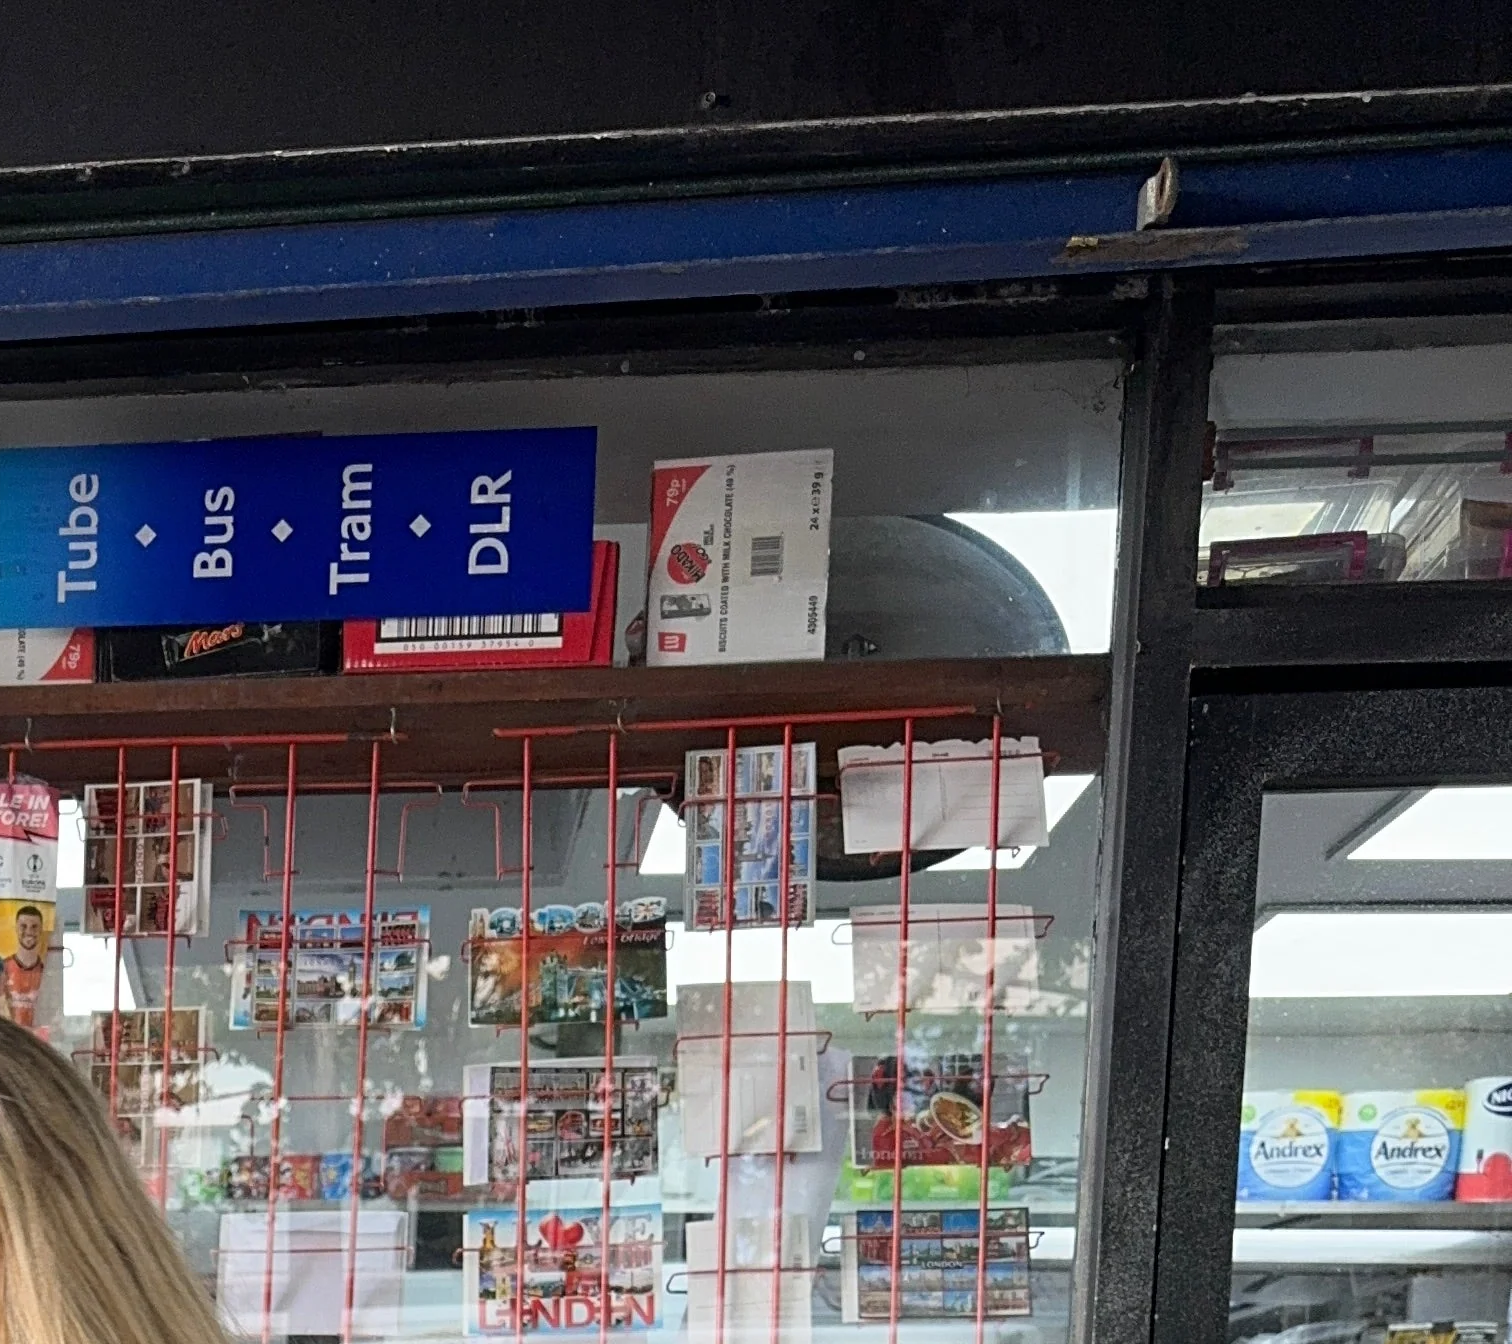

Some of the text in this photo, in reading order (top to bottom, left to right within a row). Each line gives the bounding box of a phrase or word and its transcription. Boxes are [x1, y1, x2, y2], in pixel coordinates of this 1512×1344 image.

[666, 479, 681, 507] 79p
[57, 472, 100, 604] Tube
[193, 485, 235, 579] Bus
[329, 464, 373, 595] Tram
[469, 470, 512, 576] DLR
[809, 518, 819, 531] 24
[720, 492, 734, 615] COATED WITH MILK CHOCOLATE
[184, 622, 245, 657] Mars
[27, 795, 51, 810] IN
[1254, 1140, 1325, 1160] Andrex
[1374, 1141, 1444, 1161] Andrex
[920, 1260, 964, 1269] LONDON
